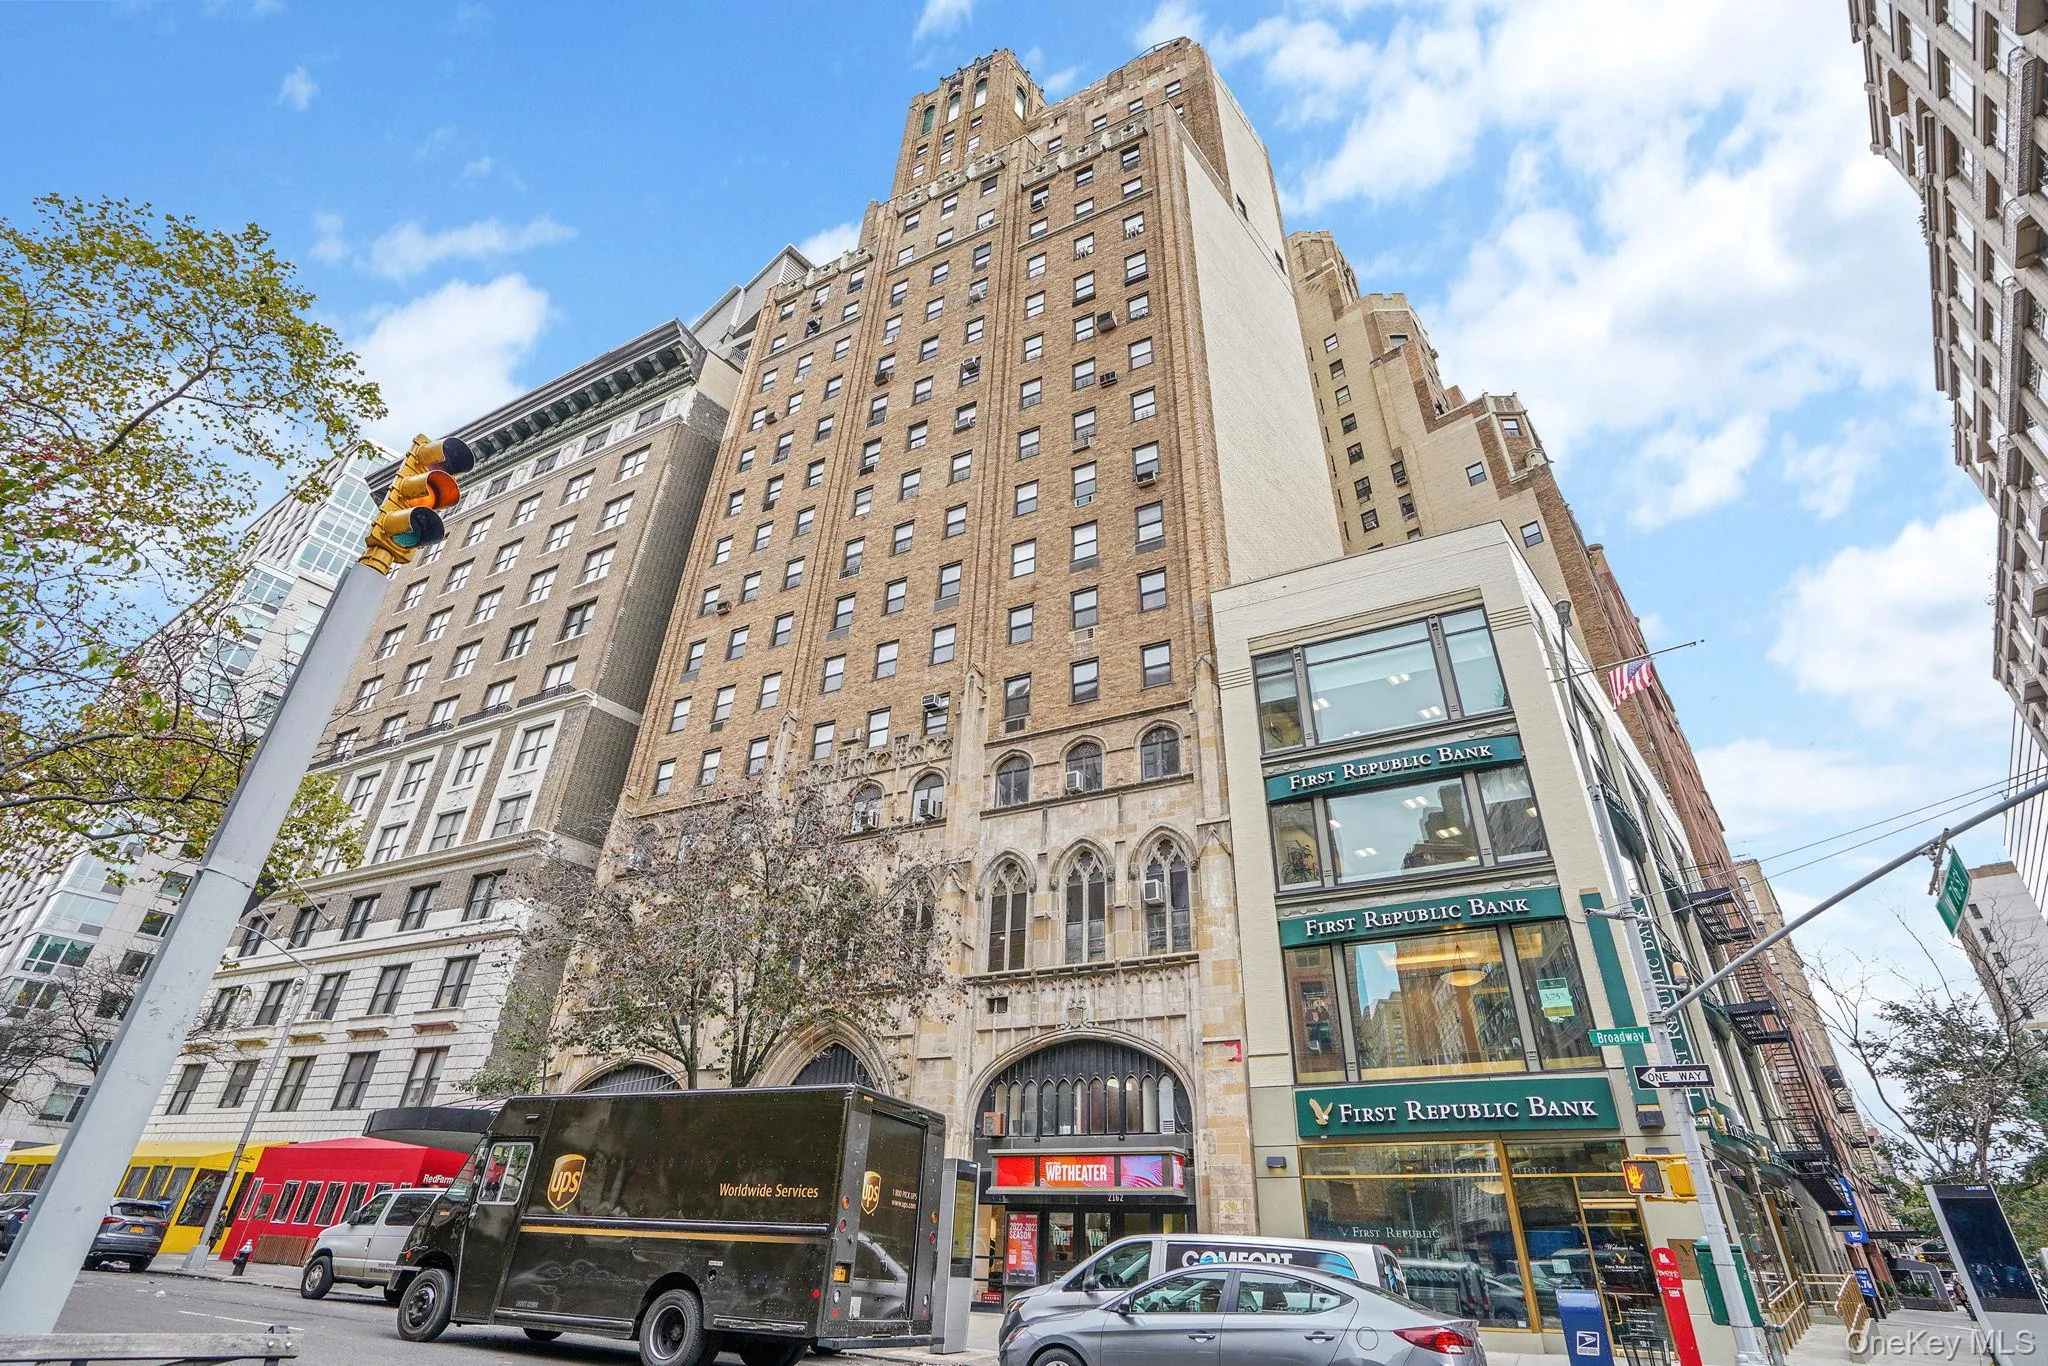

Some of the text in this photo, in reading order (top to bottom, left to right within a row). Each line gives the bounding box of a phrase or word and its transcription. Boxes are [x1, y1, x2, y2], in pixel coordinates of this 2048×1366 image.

[1289, 745, 1493, 790] FIRST REPUBLIC BANK
[1305, 898, 1530, 937] FIRST REPUBLIC BANK
[1596, 1031, 1644, 1044] Broadway
[1648, 1072, 1702, 1081] ONE WAY
[1339, 1096, 1598, 1123] FIRST REPUBLIC BANK
[423, 1174, 454, 1184] RedFarm
[551, 1171, 581, 1201] ups
[719, 1183, 819, 1198] Worldwide Services
[861, 1183, 879, 1207] ups
[1108, 1194, 1124, 1202] 2162
[1009, 1231, 1032, 1239] SEASON
[1352, 1226, 1440, 1239] FIRST REPUBLIC
[1182, 1250, 1293, 1267] COMFORT
